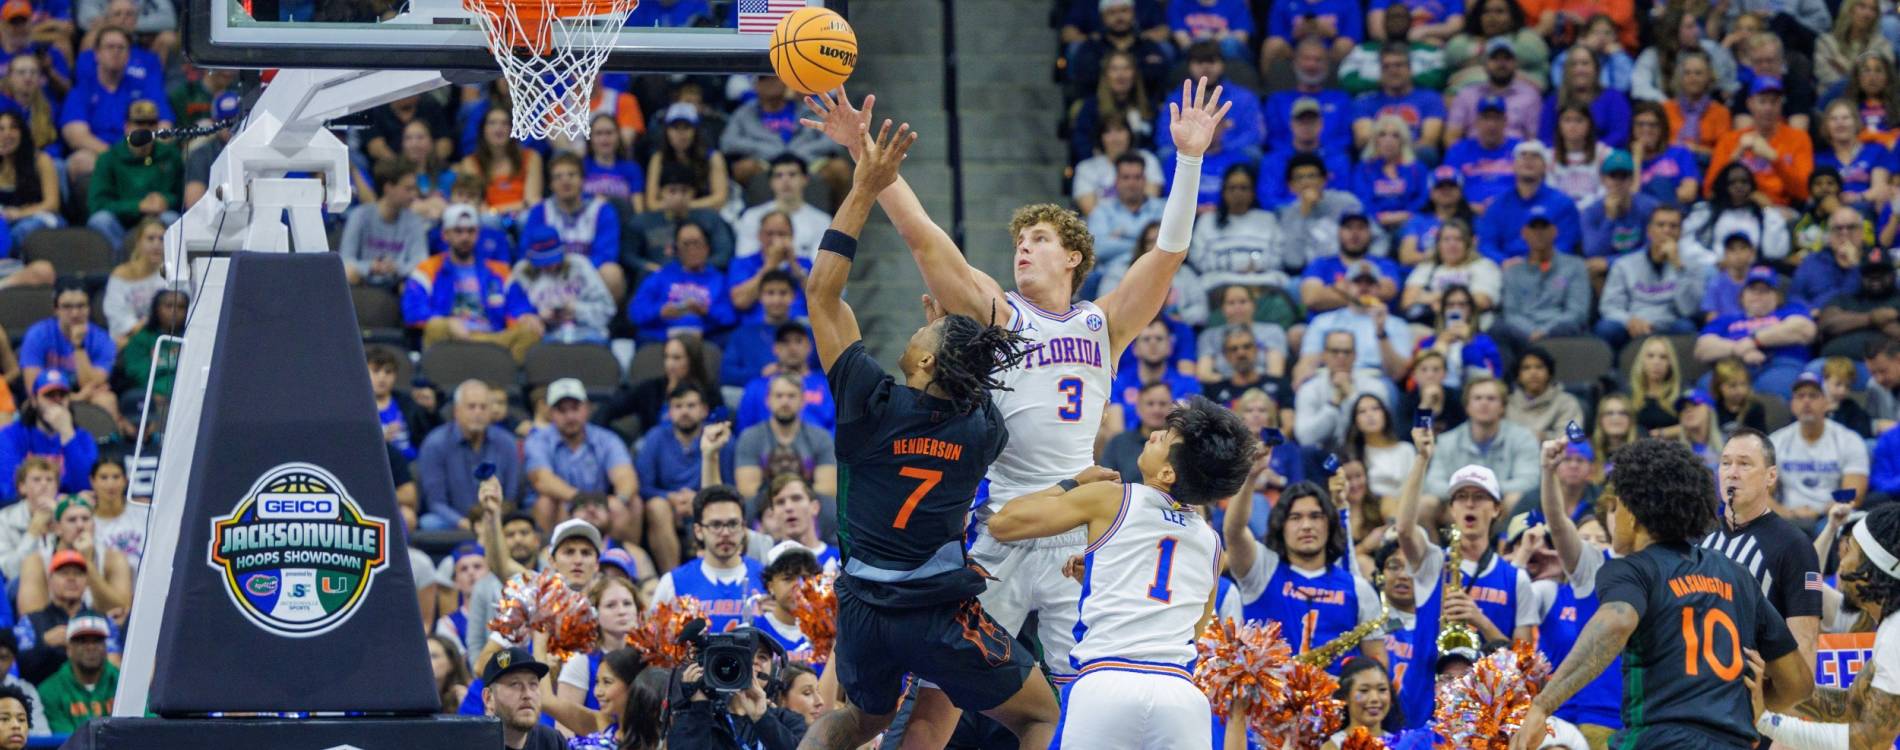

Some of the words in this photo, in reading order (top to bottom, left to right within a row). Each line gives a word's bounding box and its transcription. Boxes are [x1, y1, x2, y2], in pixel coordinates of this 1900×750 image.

[1024, 336, 1102, 369] FLORIDA
[1058, 376, 1084, 422] 3
[893, 437, 963, 461] HENDERSON
[265, 500, 332, 513] GEICO
[892, 466, 944, 529] 7
[1161, 508, 1187, 527] LEE
[222, 522, 377, 554] JACKSONVILLE
[236, 551, 280, 569] HOOPS
[284, 550, 362, 570] SHOWDOWN
[1147, 536, 1178, 605] 1
[1682, 606, 1744, 682] 10
